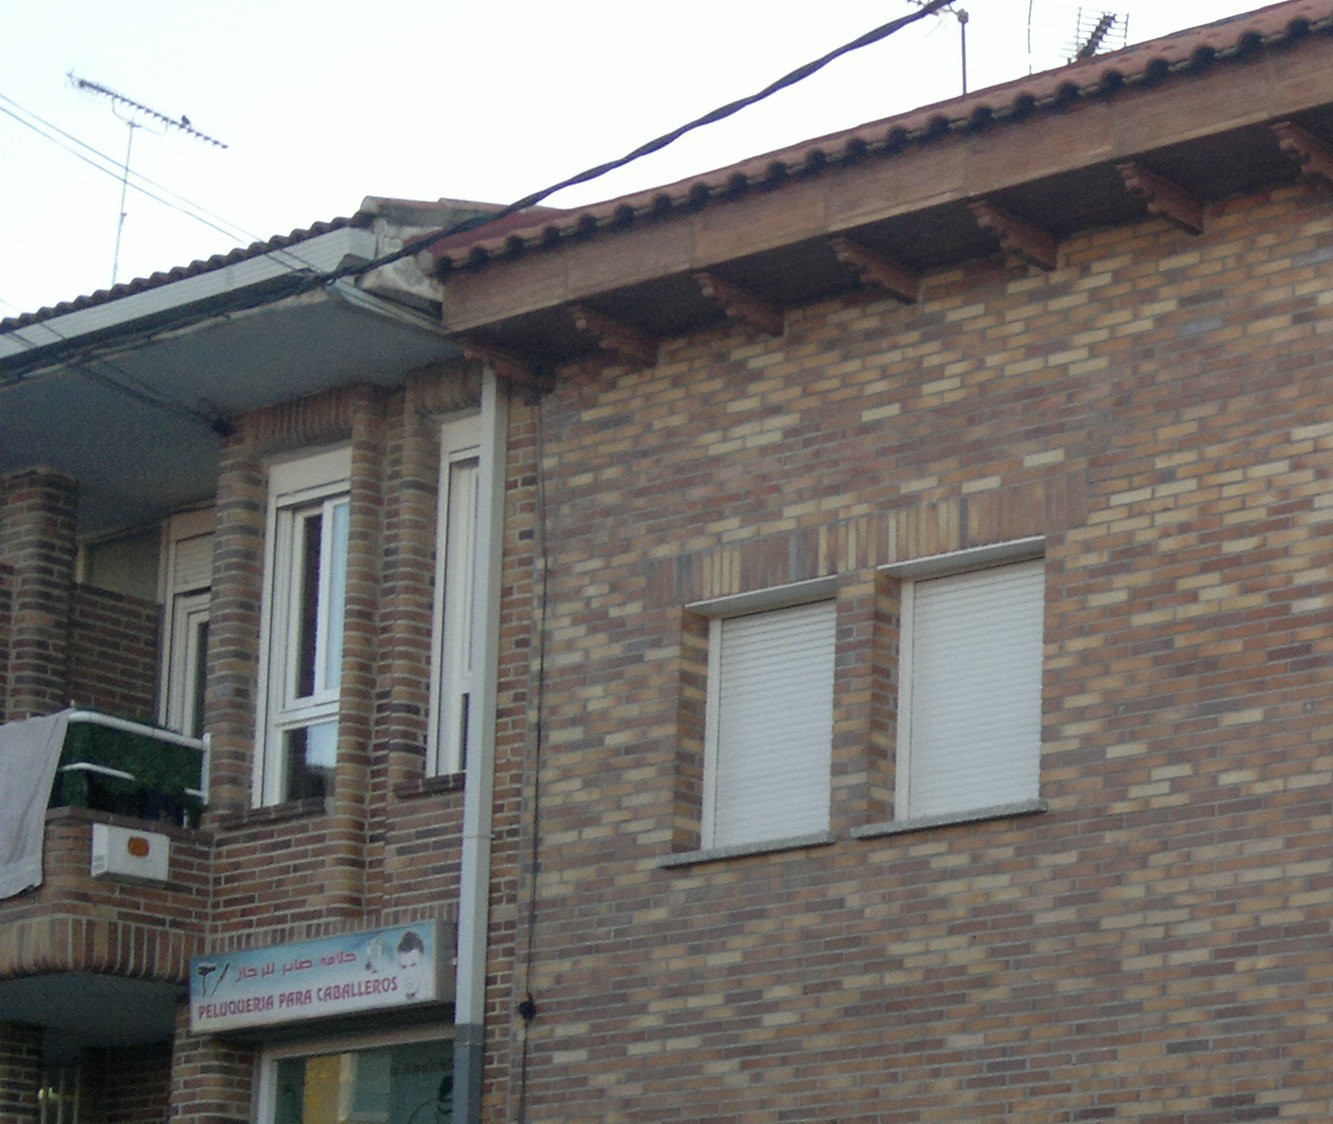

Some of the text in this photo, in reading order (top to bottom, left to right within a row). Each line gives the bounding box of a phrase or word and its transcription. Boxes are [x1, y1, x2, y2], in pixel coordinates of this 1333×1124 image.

[198, 977, 398, 1020] PELUQUERIA PARA CABALLEROS
